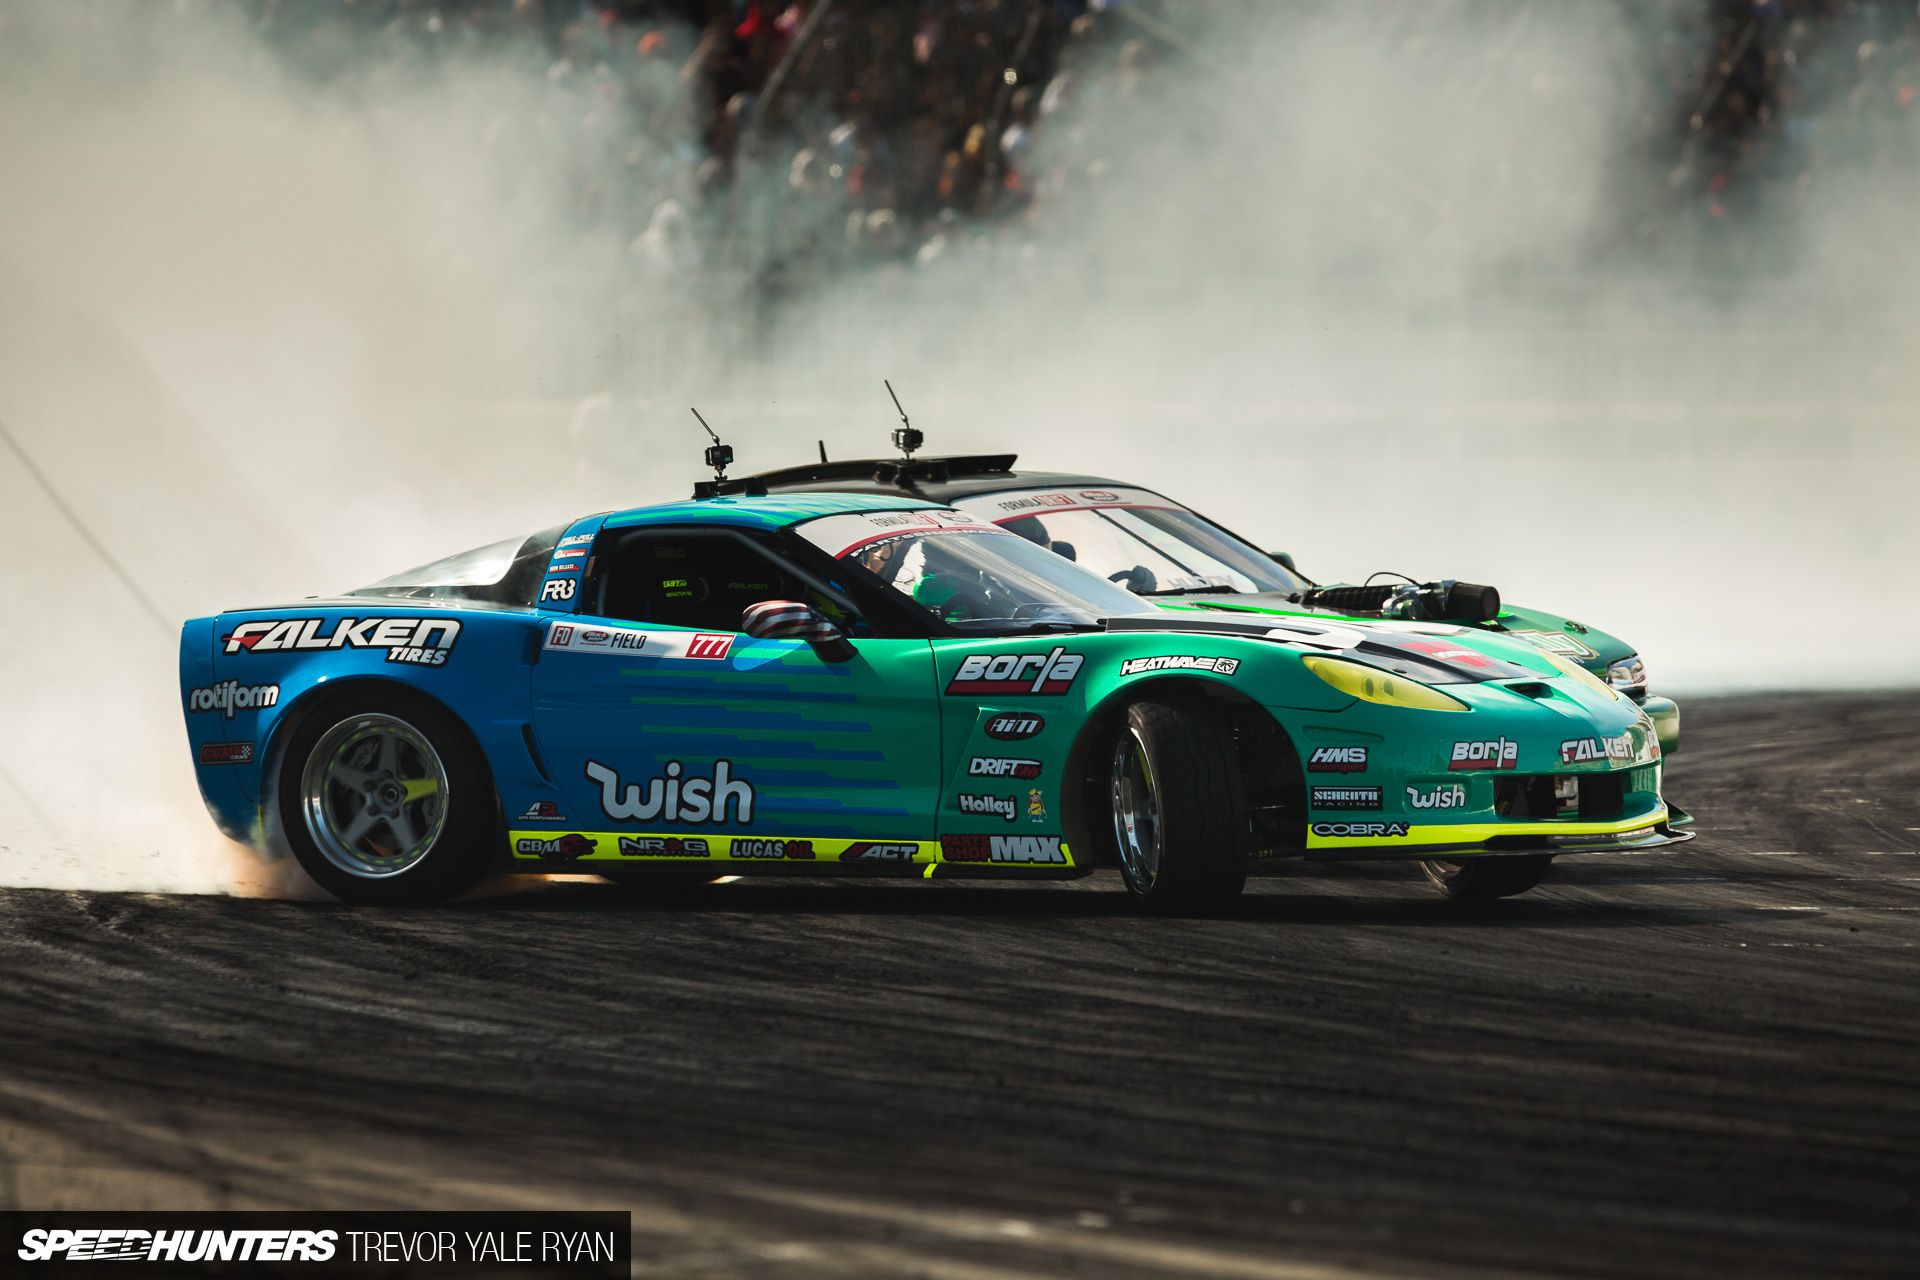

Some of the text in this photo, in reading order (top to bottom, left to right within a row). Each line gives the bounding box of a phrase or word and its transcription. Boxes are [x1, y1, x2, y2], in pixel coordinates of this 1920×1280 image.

[223, 618, 460, 652] FALKEN
[611, 633, 648, 649] FIELD
[691, 636, 731, 655] 777
[389, 648, 447, 665] TIRES
[1121, 657, 1216, 675] HEATWAVE
[190, 681, 279, 717] rotiform
[1311, 748, 1366, 762] HMS
[1562, 736, 1635, 762] FALKEN
[969, 758, 1040, 775] DRIFT
[587, 761, 752, 822] wish
[1314, 791, 1377, 800] SCHROTH
[1407, 785, 1464, 808] wish
[960, 795, 1015, 819] Holley
[732, 841, 784, 857] LUCAS
[861, 845, 916, 859] ACT
[990, 836, 1064, 862] MAX
